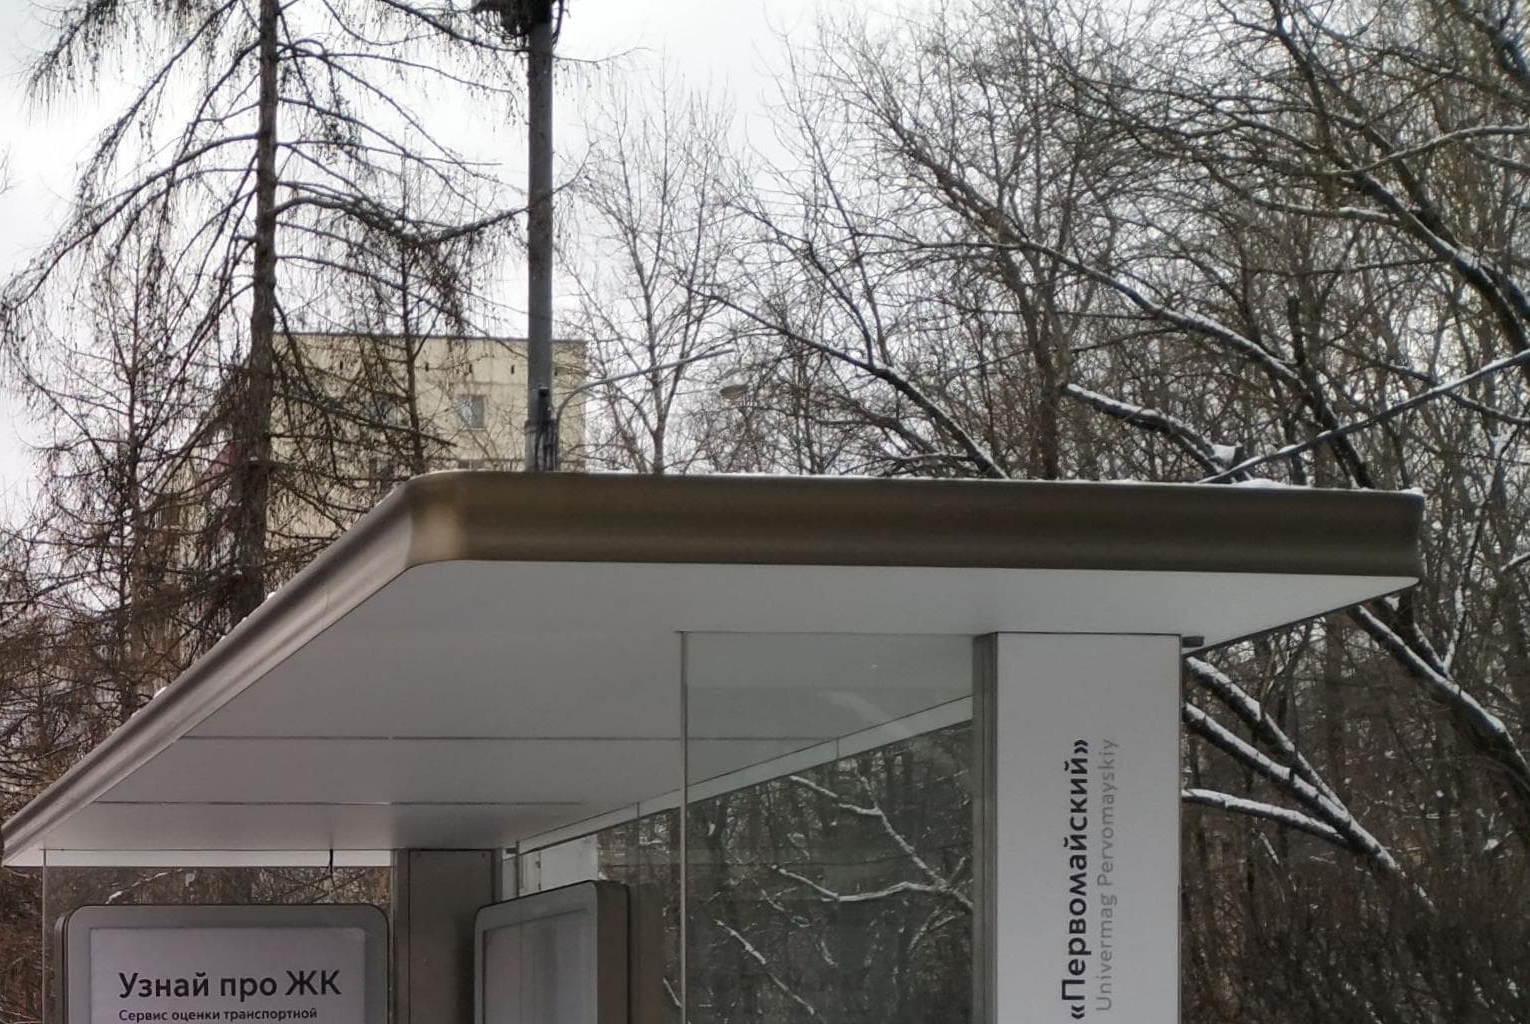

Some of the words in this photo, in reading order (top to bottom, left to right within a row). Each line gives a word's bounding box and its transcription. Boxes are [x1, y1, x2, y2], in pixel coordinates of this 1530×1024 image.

[1096, 738, 1119, 887] Pervomayskiy
[1061, 738, 1092, 1021] «Первомайский»
[118, 971, 209, 999] Узнай
[220, 976, 278, 1002] про
[285, 969, 342, 997] ЖК
[1095, 894, 1117, 1012] Univermag
[118, 1009, 168, 1023] Сервис
[171, 1010, 221, 1022] оценки
[224, 1007, 318, 1021] транспортной
